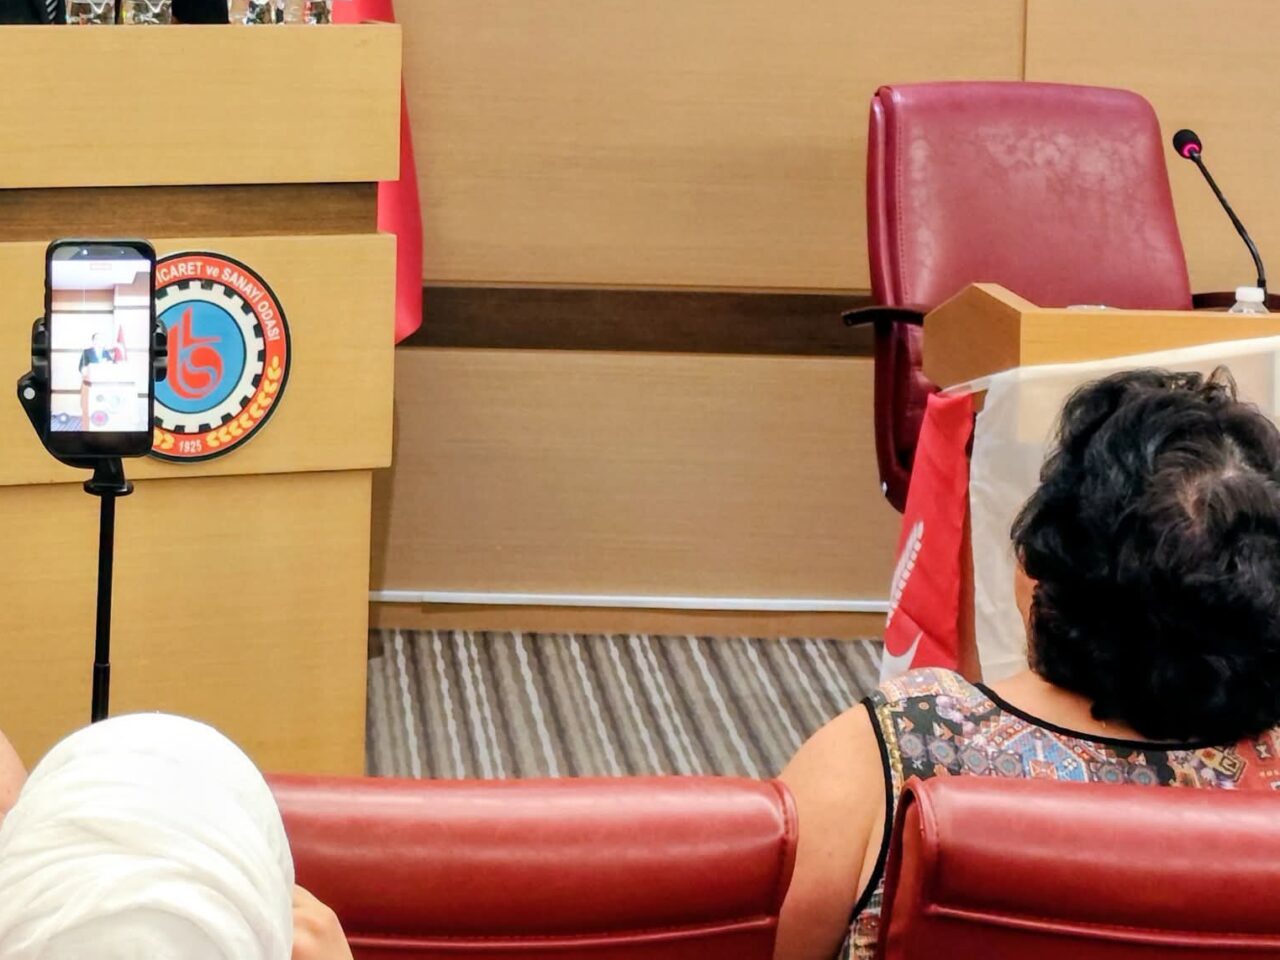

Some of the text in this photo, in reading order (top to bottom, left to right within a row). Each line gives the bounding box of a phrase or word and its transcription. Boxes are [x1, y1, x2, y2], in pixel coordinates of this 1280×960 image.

[155, 262, 280, 341] İCARET ve SANAYİ ODASI
[178, 439, 203, 453] 1925
